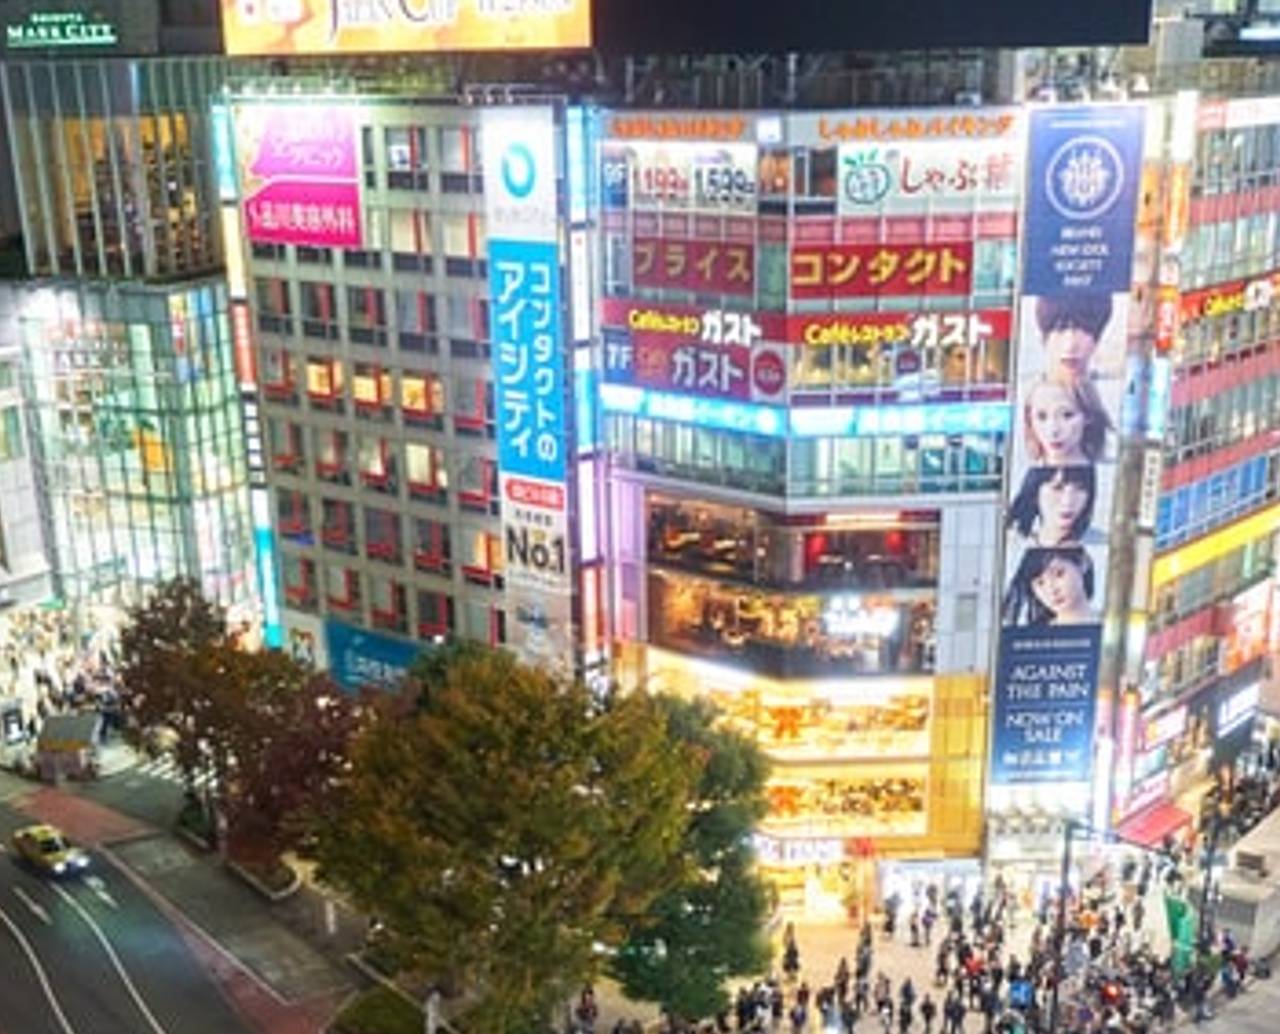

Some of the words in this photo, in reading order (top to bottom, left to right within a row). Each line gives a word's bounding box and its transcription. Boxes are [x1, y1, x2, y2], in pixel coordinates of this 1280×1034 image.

[792, 247, 966, 285] コンタクト
[701, 310, 763, 347] ガスト
[911, 312, 994, 348] ガスト
[494, 260, 534, 458] アイシティ
[529, 262, 558, 462] コンタクトの
[672, 347, 744, 392] ガスト
[506, 524, 564, 575] No.1
[1007, 683, 1042, 700] THE
[1048, 682, 1090, 700] PAIN
[1011, 664, 1088, 681] AGAINST
[1006, 711, 1051, 729] NOW
[1054, 710, 1084, 726] ON
[1023, 727, 1062, 743] SALE
